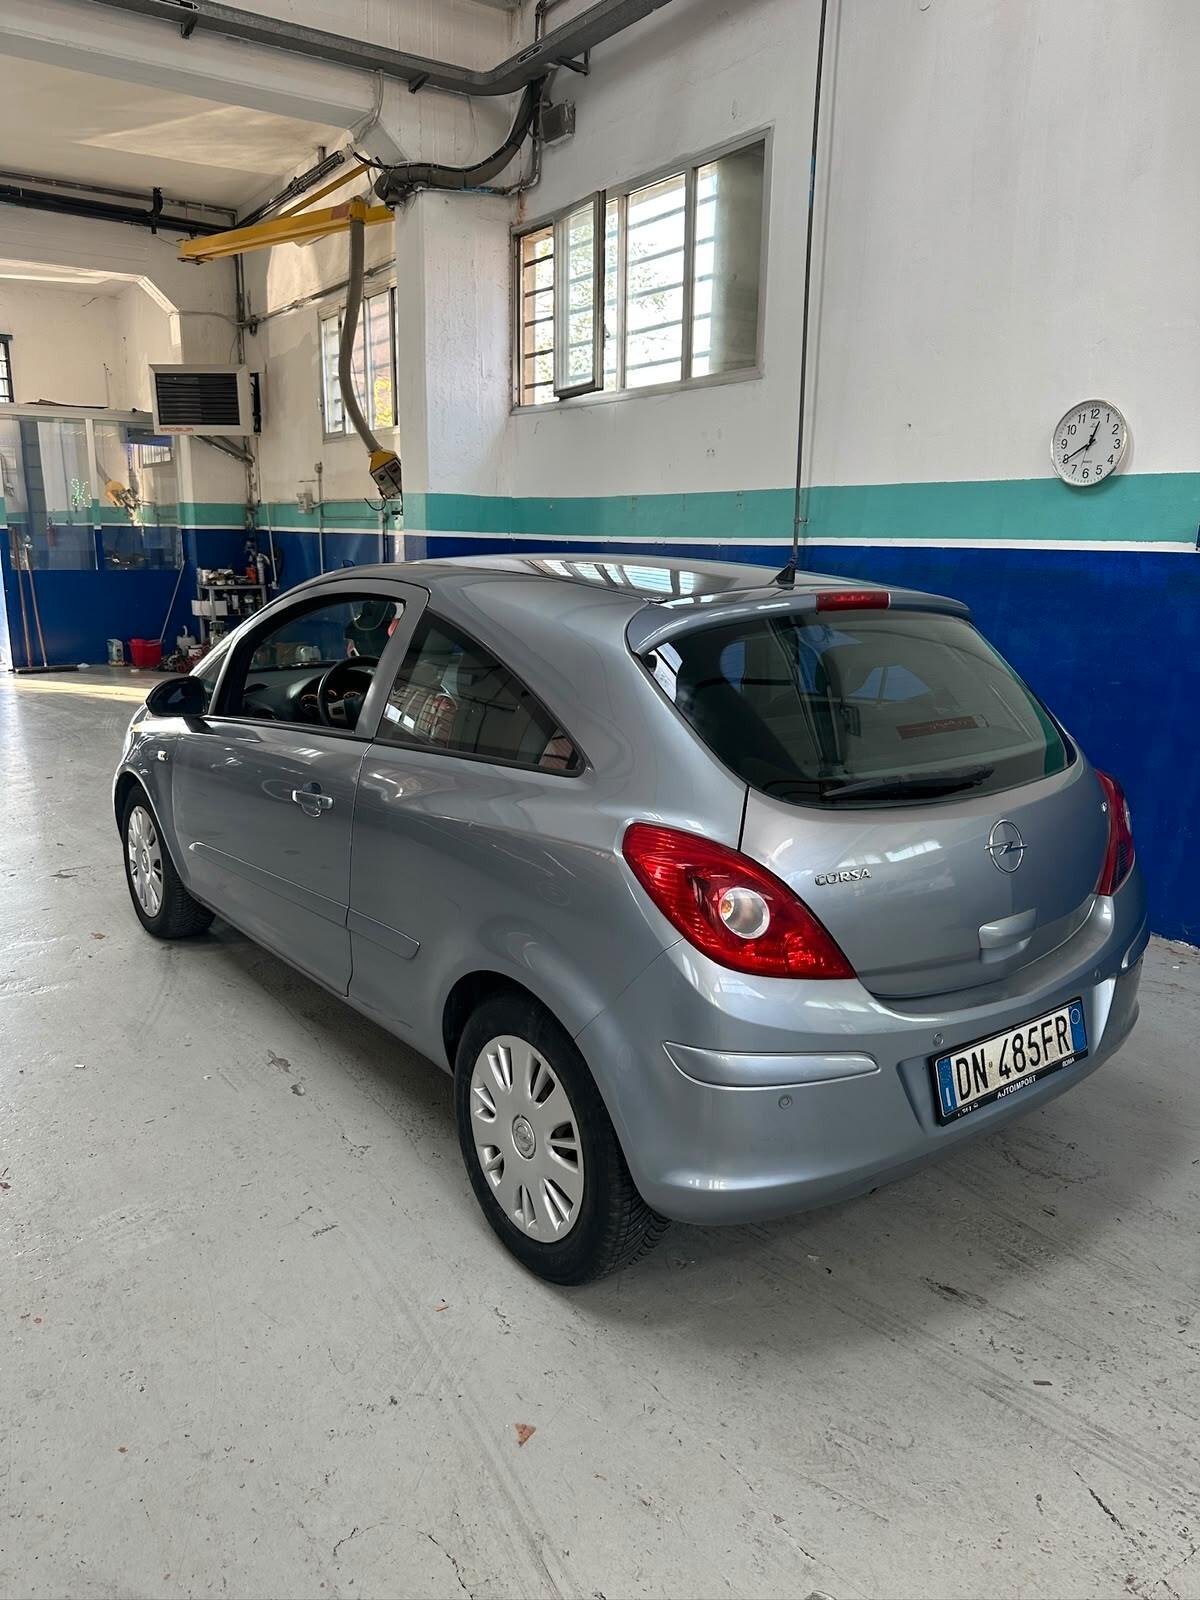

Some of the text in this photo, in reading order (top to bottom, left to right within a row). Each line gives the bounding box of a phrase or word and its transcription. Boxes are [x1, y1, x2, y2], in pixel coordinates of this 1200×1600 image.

[1078, 413, 1087, 424] 11
[1090, 408, 1100, 420] 12
[1106, 413, 1110, 424] 1
[1067, 424, 1077, 436] 10
[1112, 423, 1120, 435] 2
[1061, 438, 1068, 450] 9
[1113, 438, 1121, 450] 3
[1062, 454, 1069, 464] 8
[1107, 454, 1114, 465] 4
[1071, 464, 1078, 474] 7
[1082, 468, 1090, 479] 6
[1095, 465, 1103, 475] 5
[815, 868, 872, 886] CORSA
[955, 1015, 1071, 1101] DN 485FR
